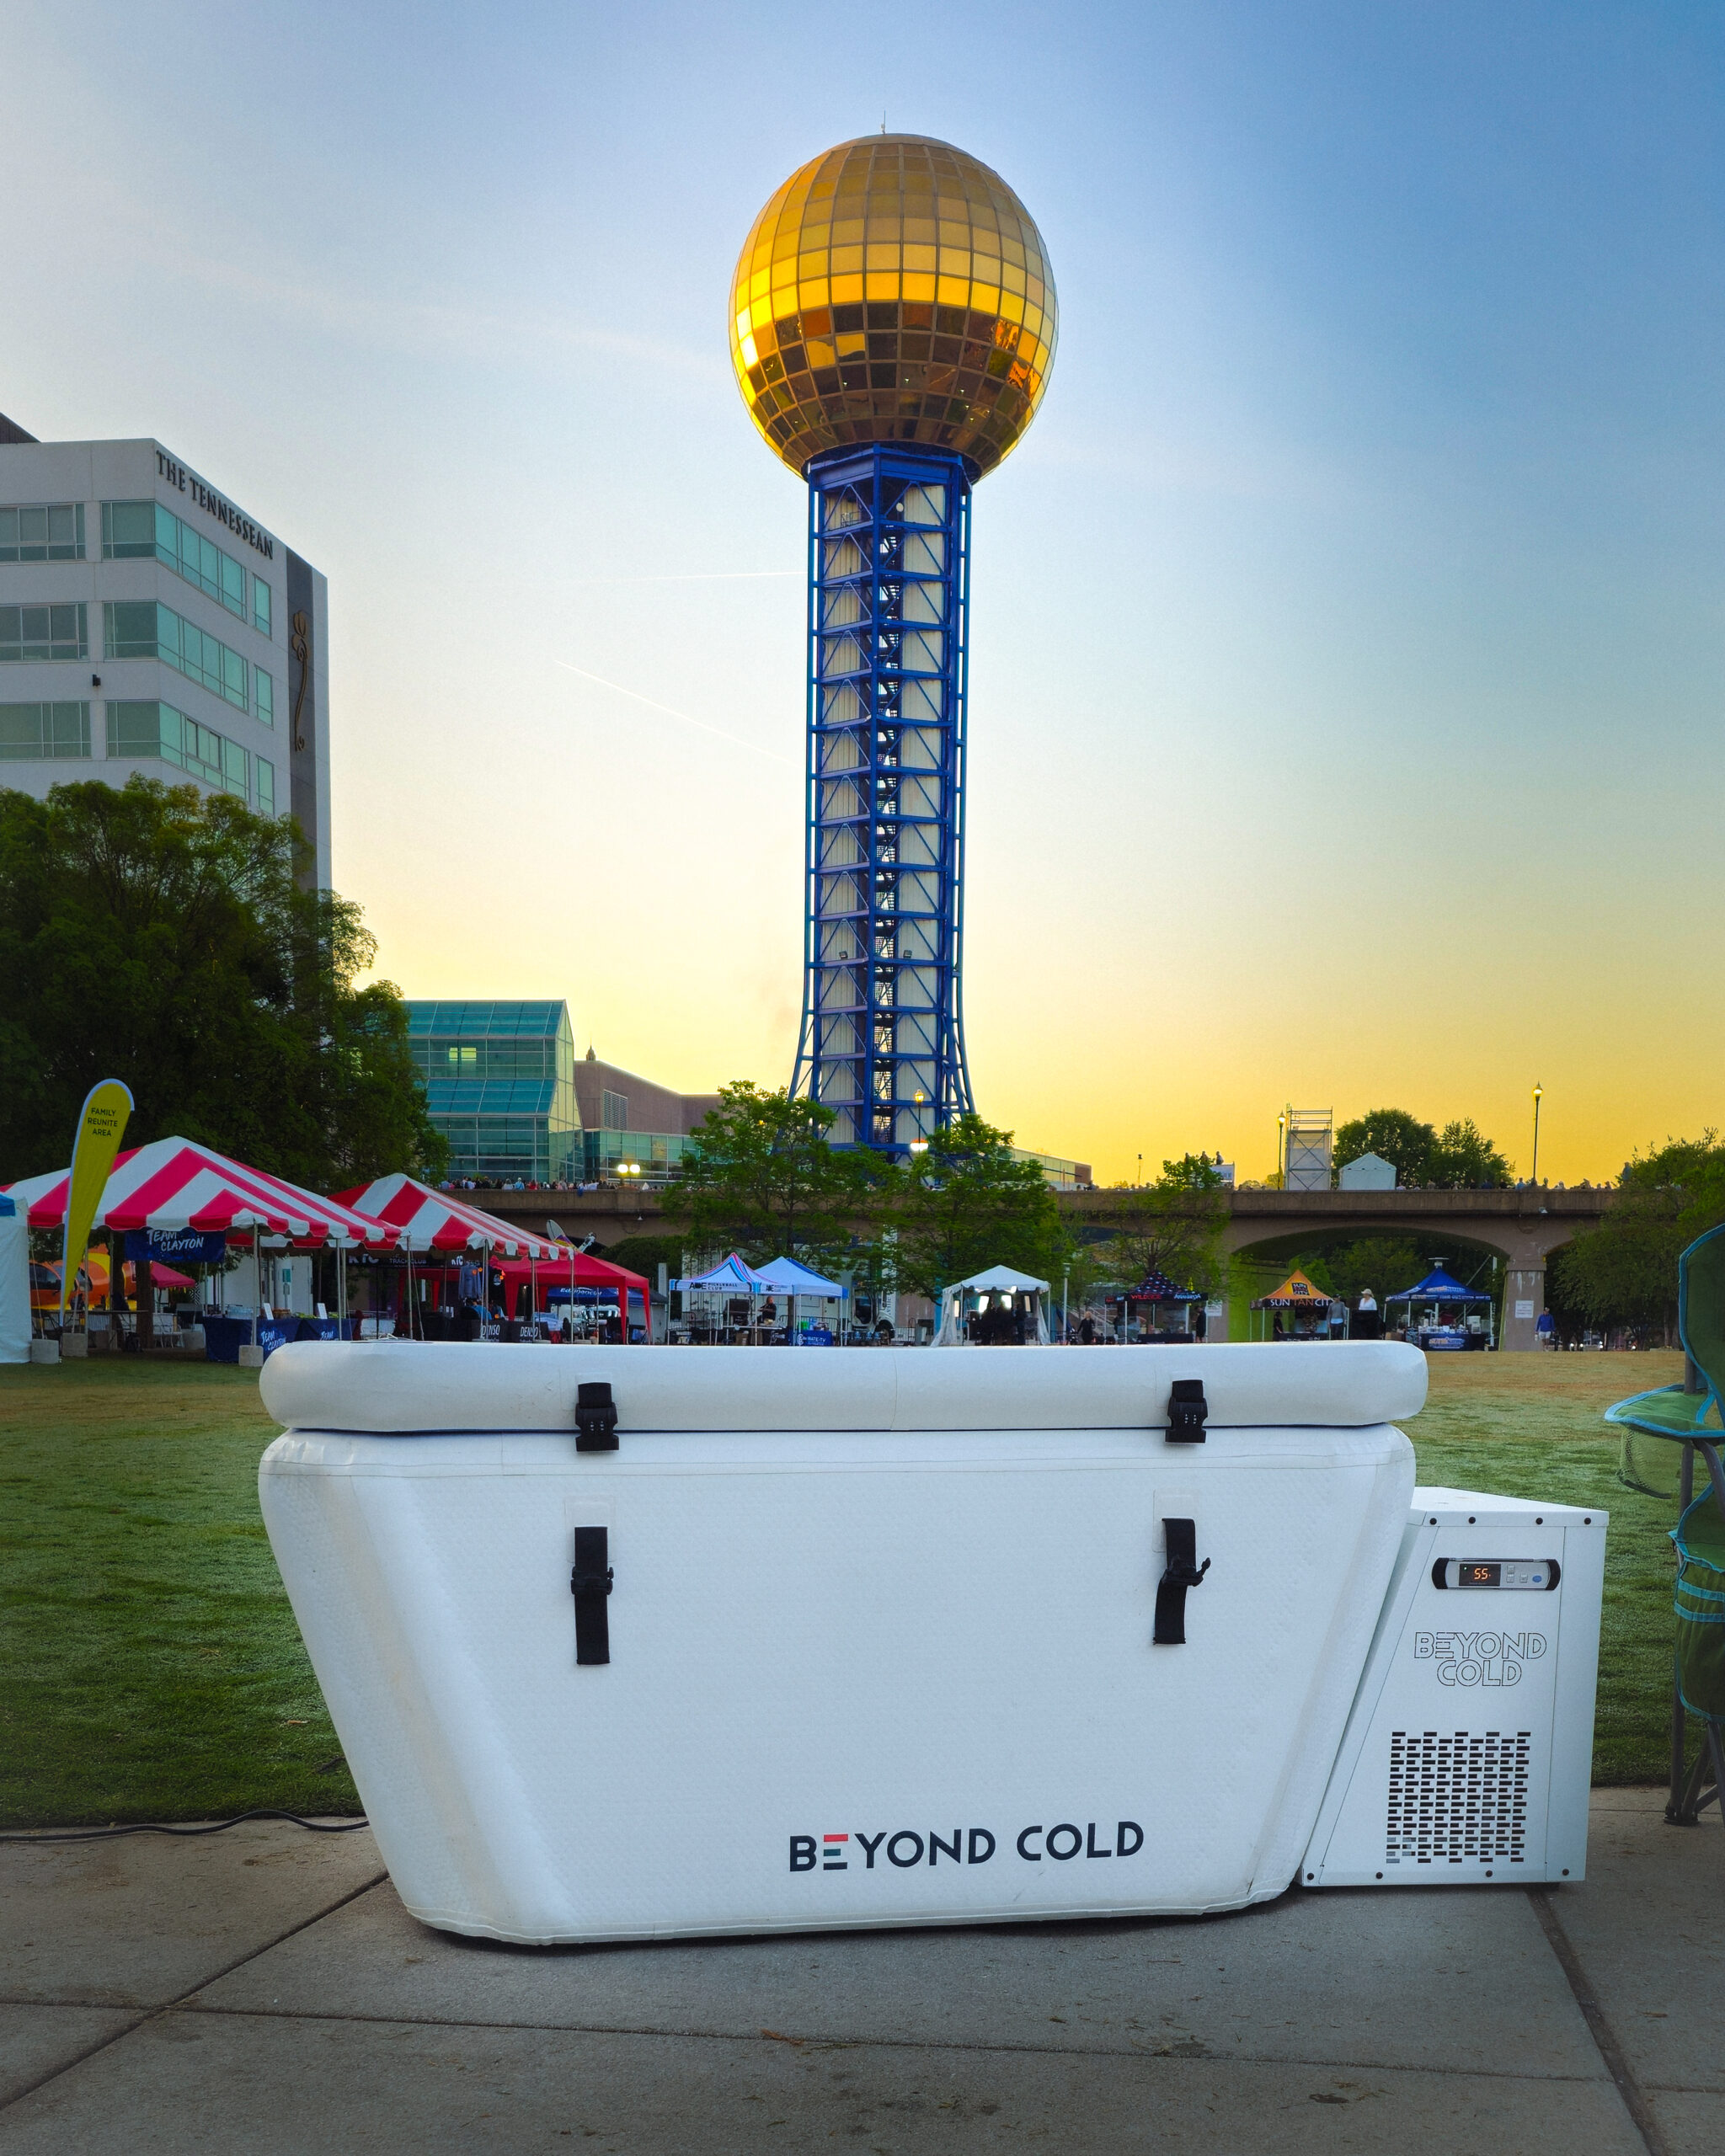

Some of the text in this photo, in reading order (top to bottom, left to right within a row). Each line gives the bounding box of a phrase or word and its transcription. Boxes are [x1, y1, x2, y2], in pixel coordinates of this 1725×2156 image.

[156, 450, 274, 560] THE TENNESSEAN
[91, 1107, 116, 1117] FAMILY
[88, 1117, 119, 1127] REUNITE
[93, 1128, 112, 1137] AREA
[147, 1229, 177, 1246] TEAM
[160, 1236, 204, 1251] CLAYTON
[1270, 1299, 1290, 1307] SUN
[1294, 1299, 1313, 1307] TAN
[482, 1324, 500, 1336] DNSO
[1474, 1567, 1489, 1580] 55
[1414, 1631, 1547, 1660] BEYOND
[1437, 1659, 1523, 1687] COLD
[789, 1820, 1144, 1872] BEYOND COLD
